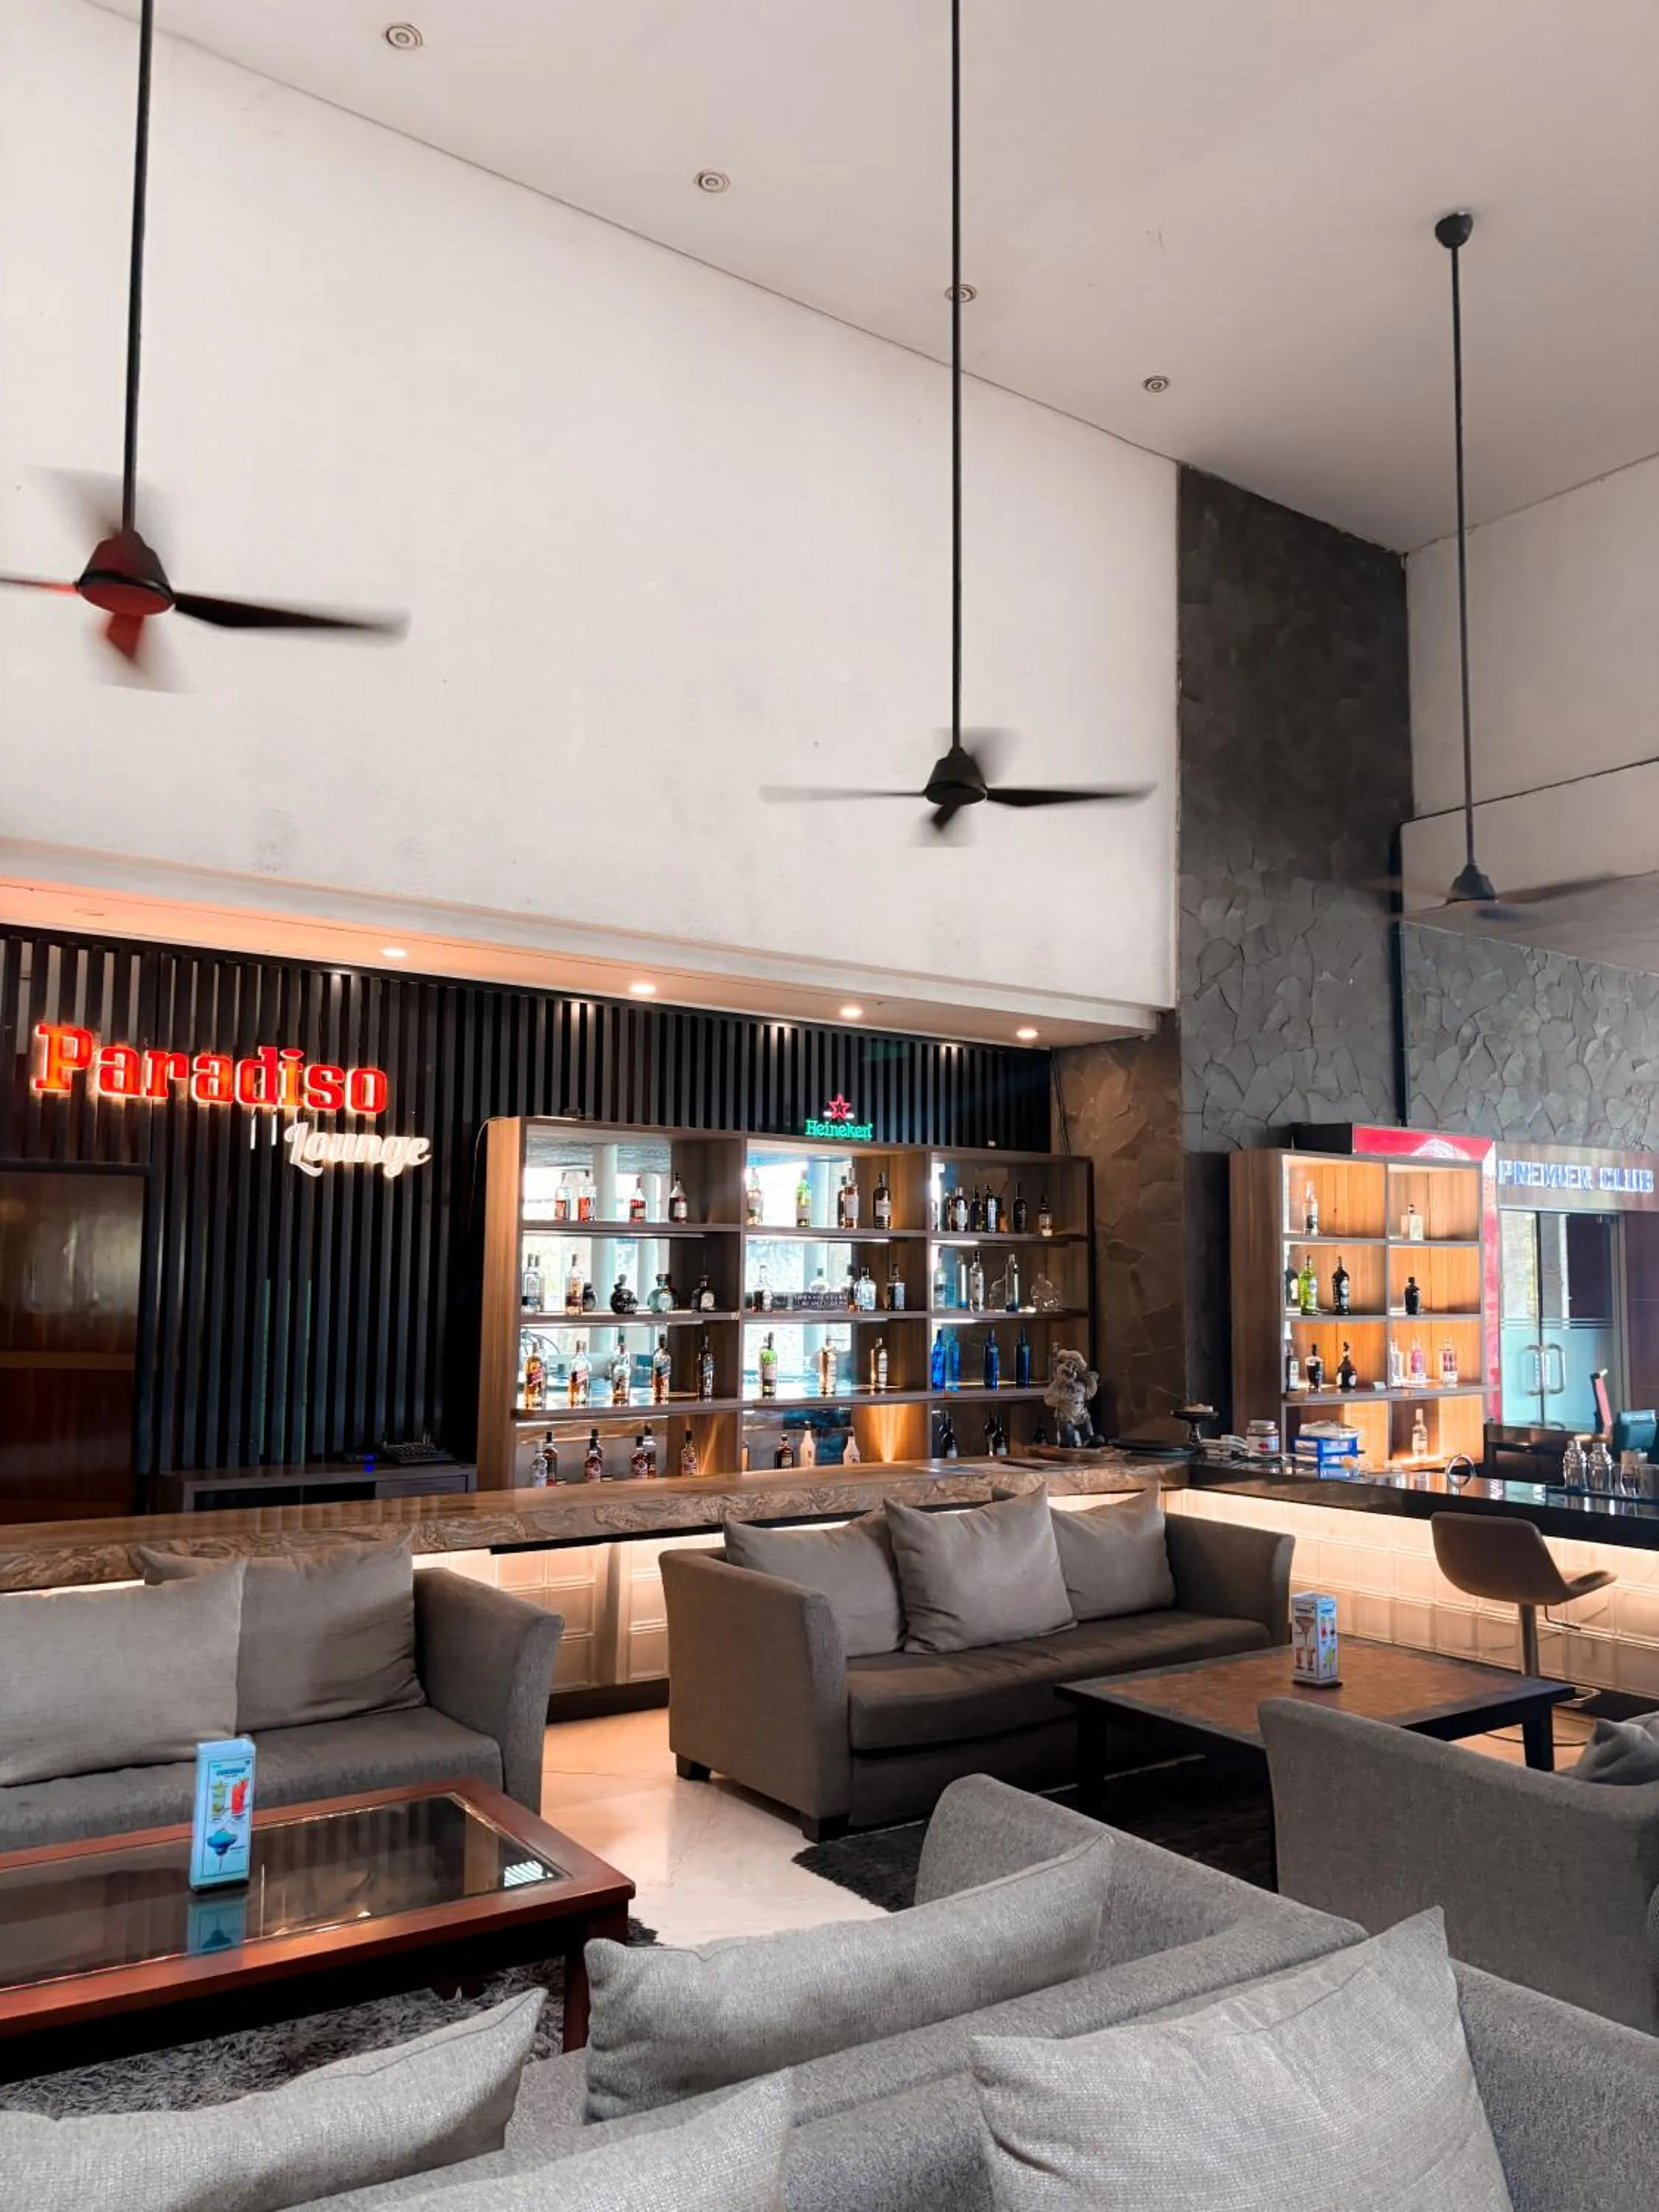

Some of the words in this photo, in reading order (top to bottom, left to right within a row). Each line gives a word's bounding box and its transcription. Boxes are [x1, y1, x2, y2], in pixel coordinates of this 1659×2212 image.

[32, 1022, 387, 1114] Paradiso
[285, 1121, 431, 1178] Lounge
[805, 1119, 873, 1138] Heineken
[1498, 1160, 1593, 1190] PREMIER
[1599, 1168, 1654, 1192] CLUB
